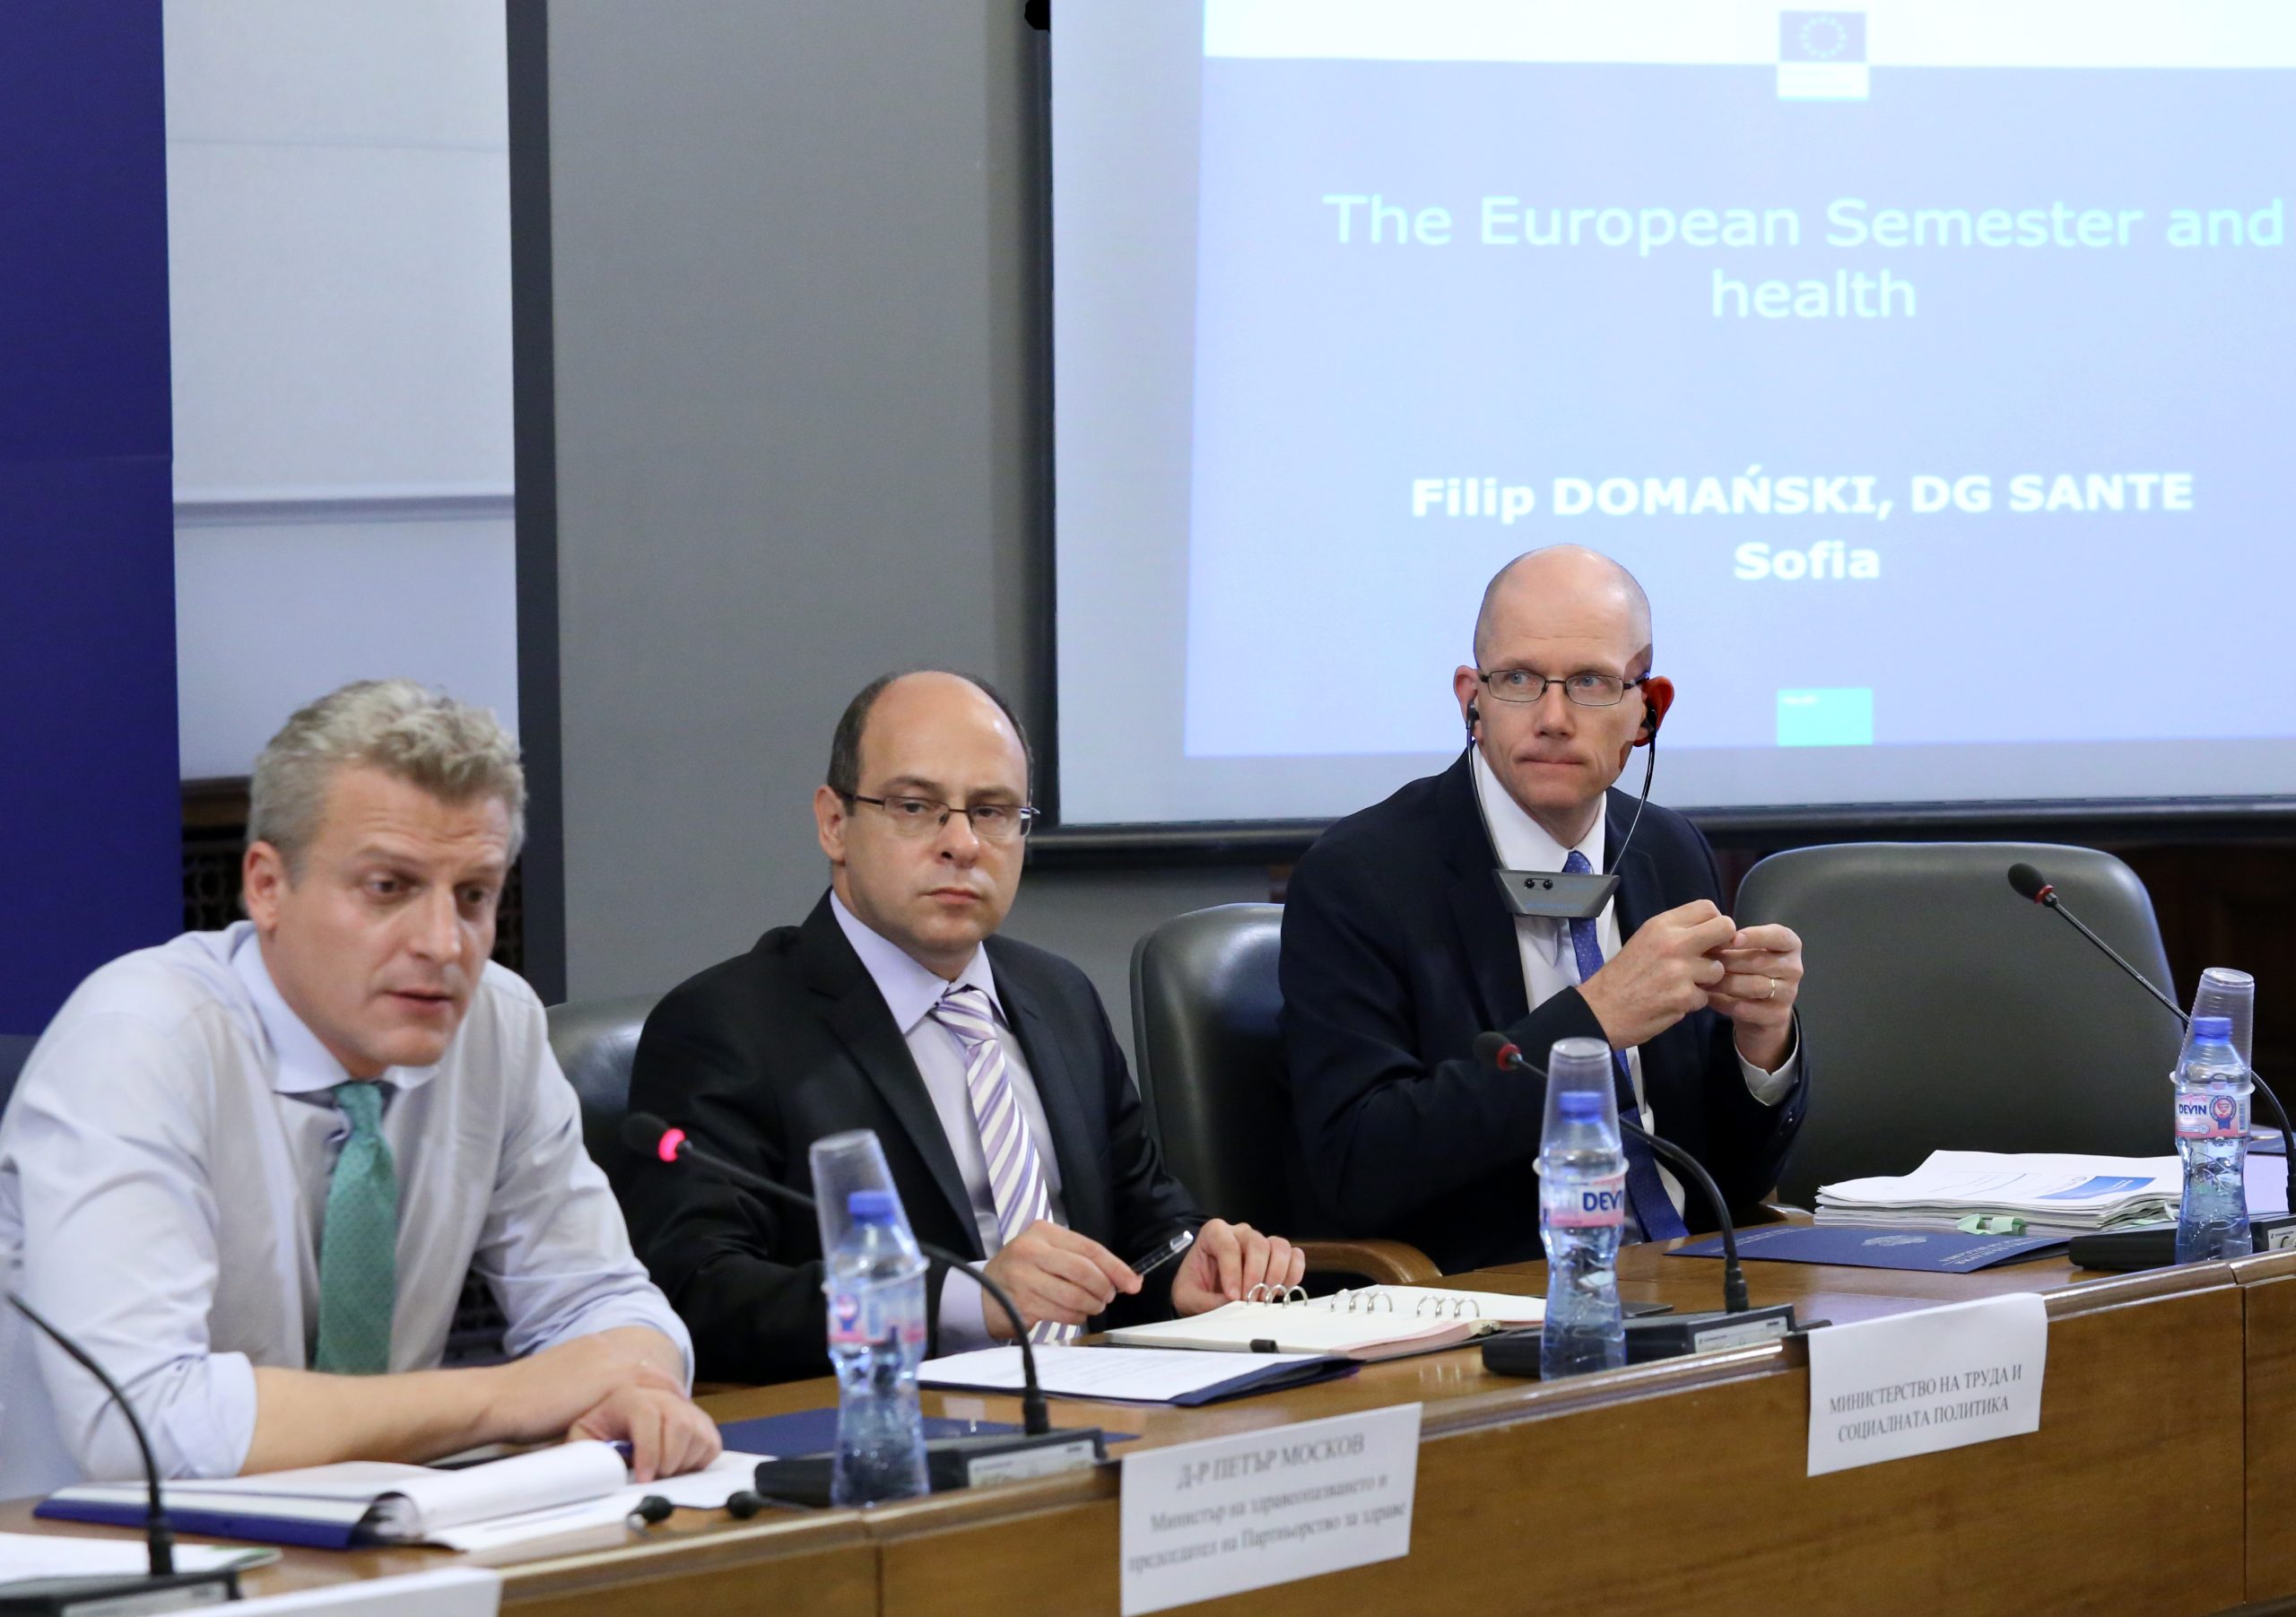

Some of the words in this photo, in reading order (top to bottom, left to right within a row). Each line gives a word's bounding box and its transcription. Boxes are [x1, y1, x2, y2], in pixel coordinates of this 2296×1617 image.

[1322, 195, 1452, 247] The
[1482, 197, 1801, 257] European
[1826, 199, 2138, 248] Semester
[2167, 196, 2284, 248] and
[1713, 270, 1917, 318] health
[1413, 477, 1535, 524] Filip
[1553, 465, 1892, 519] DOMAŃSKI,
[1912, 475, 1991, 512] DG
[2010, 474, 2193, 511] SANTE
[1735, 541, 1880, 579] Sofia
[2179, 1104, 2207, 1115] DEVIN
[1831, 1378, 1936, 1413] МИНИСТЕРСТВО
[1941, 1375, 1960, 1392] НА
[1964, 1368, 2009, 1389] ТРУДА
[2013, 1364, 2022, 1380] И
[1838, 1410, 1930, 1442] СОЦИАЛНАТА
[1935, 1396, 2009, 1422] ПОЛИТИКА
[1178, 1463, 1210, 1490] Д-Р
[1213, 1448, 1277, 1481] ПЕТЪР
[1281, 1433, 1365, 1465] МОСКОВ
[1230, 1503, 1246, 1517] на
